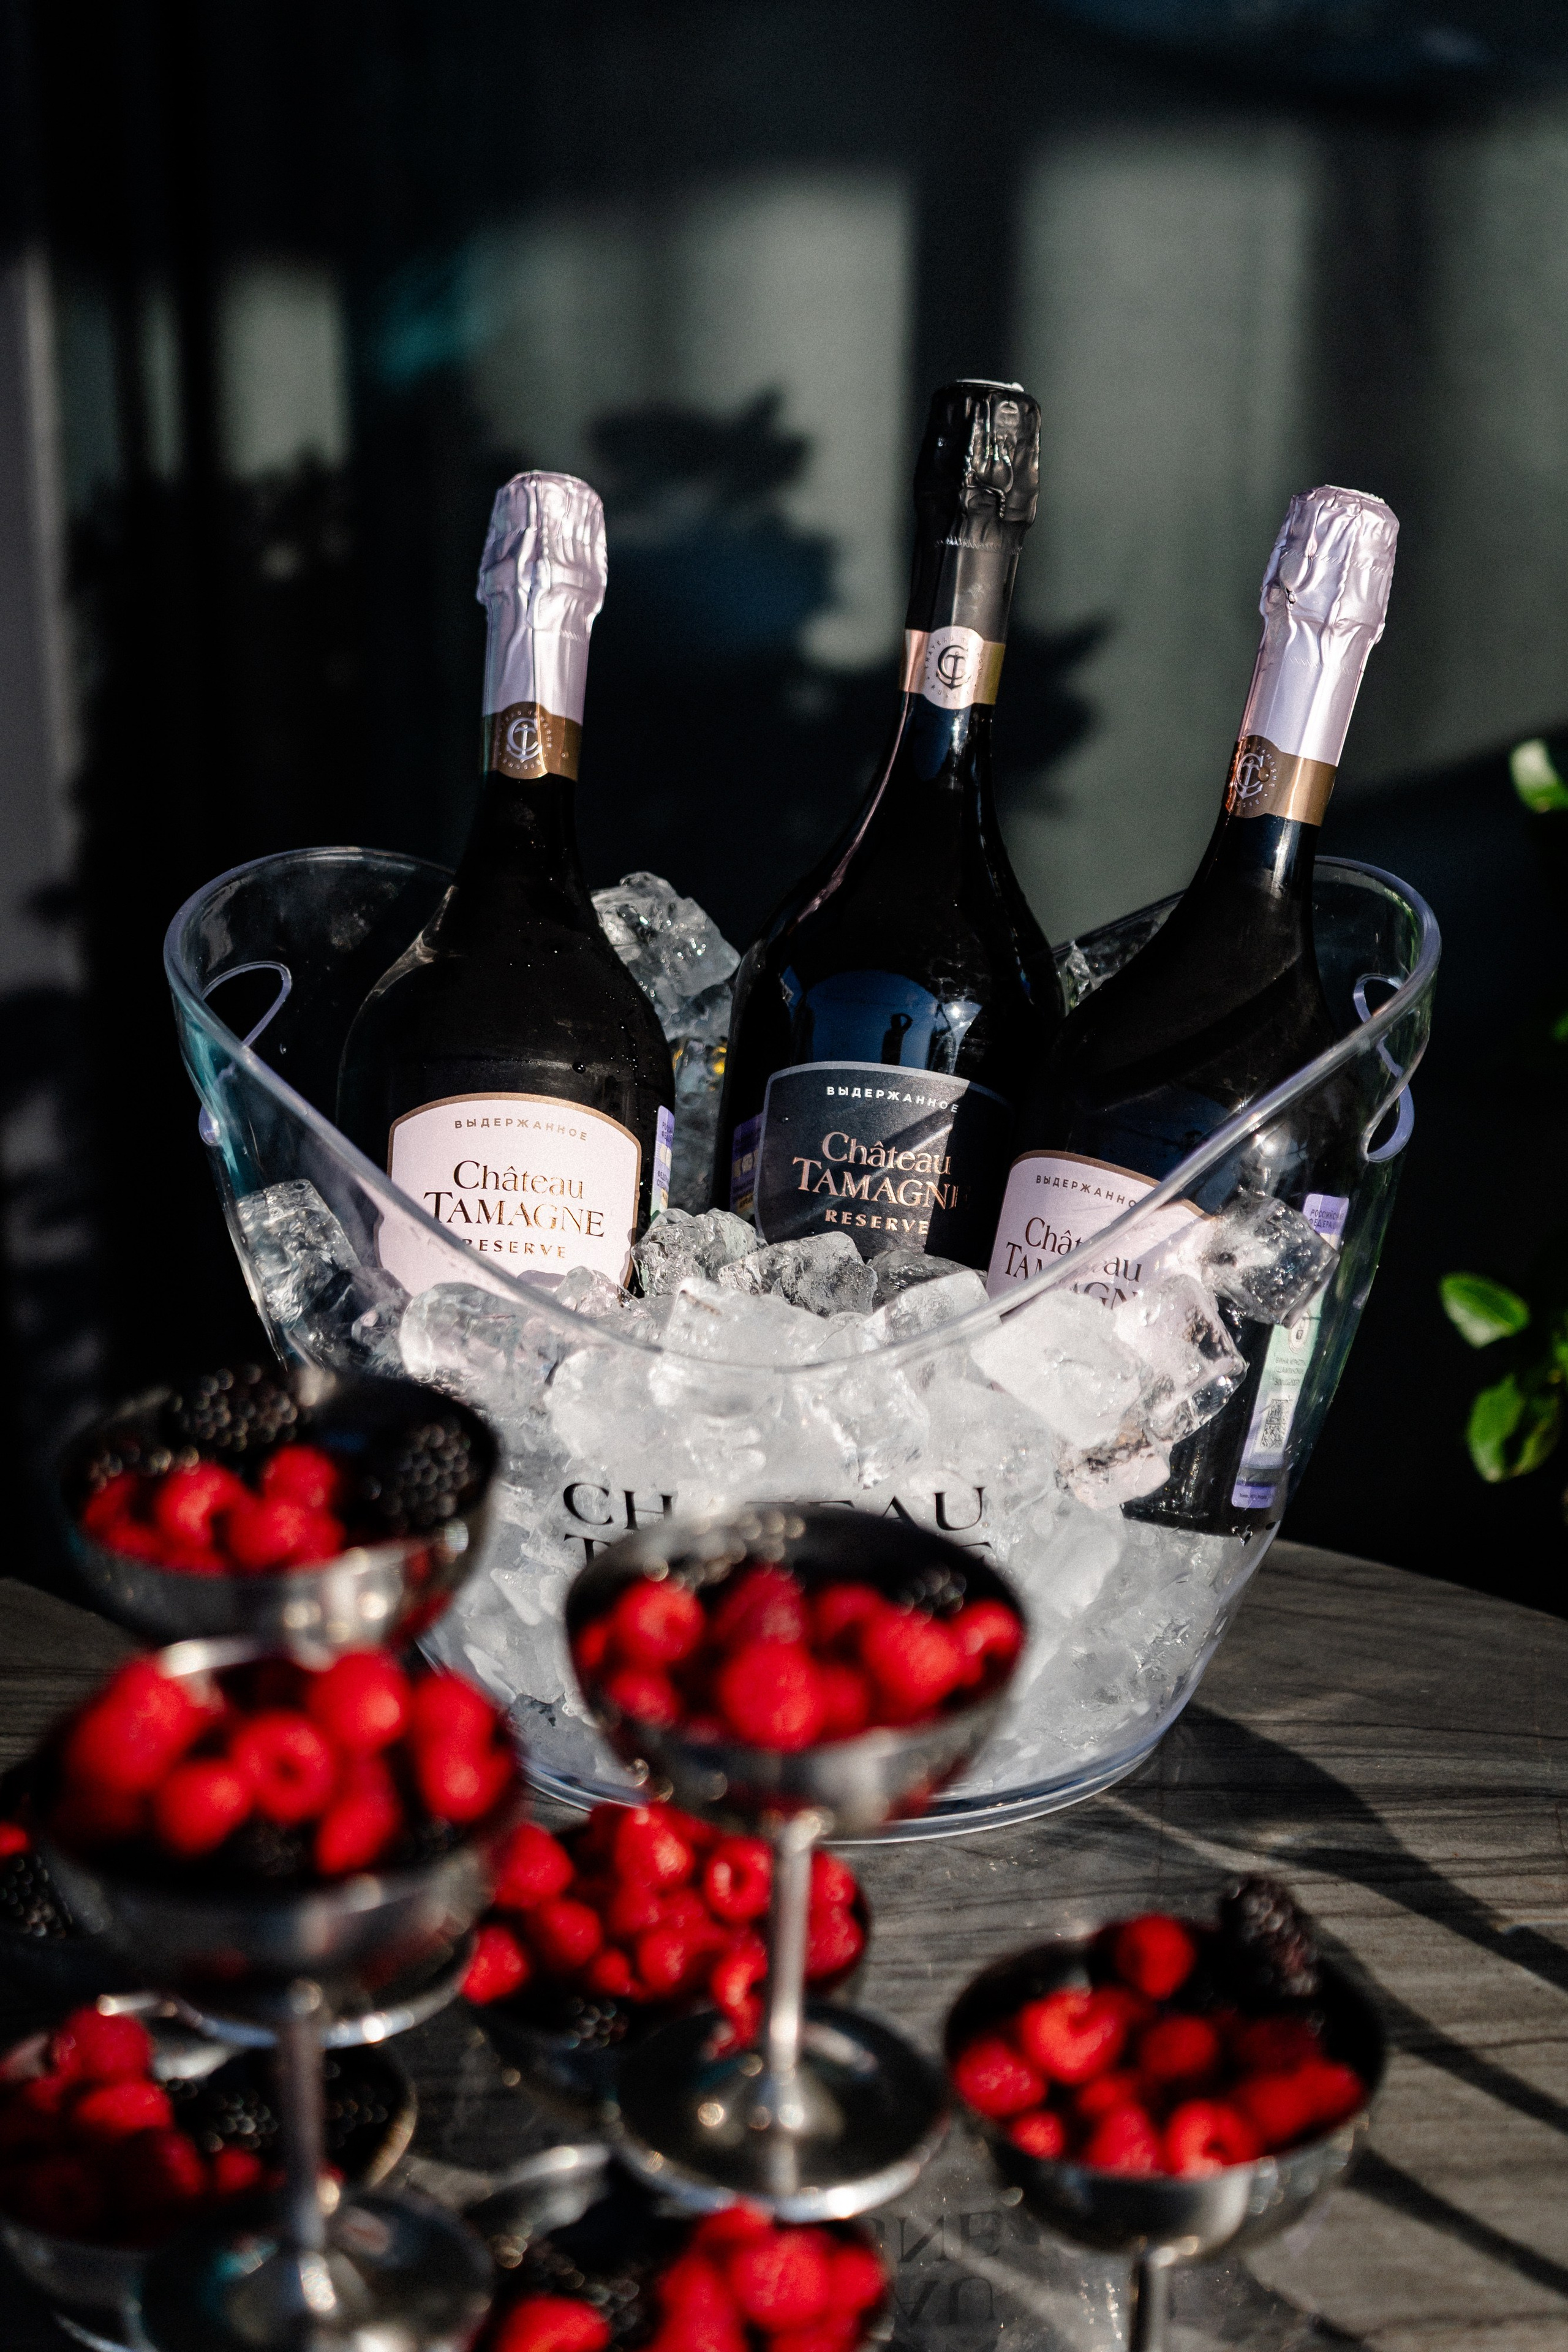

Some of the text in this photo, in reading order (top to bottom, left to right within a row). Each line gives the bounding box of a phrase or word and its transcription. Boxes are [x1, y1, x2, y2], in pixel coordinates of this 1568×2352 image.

[826, 1086, 959, 1114] ВЫДЕРЖАННОЕ
[454, 1118, 587, 1141] ВЫДЕРЖАННОЕ
[821, 1131, 952, 1175] Château
[453, 1160, 583, 1199] Château
[1036, 1175, 1137, 1208] ВЫДЕРЖАННО
[423, 1192, 604, 1237] TAMAGNE
[825, 1209, 930, 1235] RESERVE
